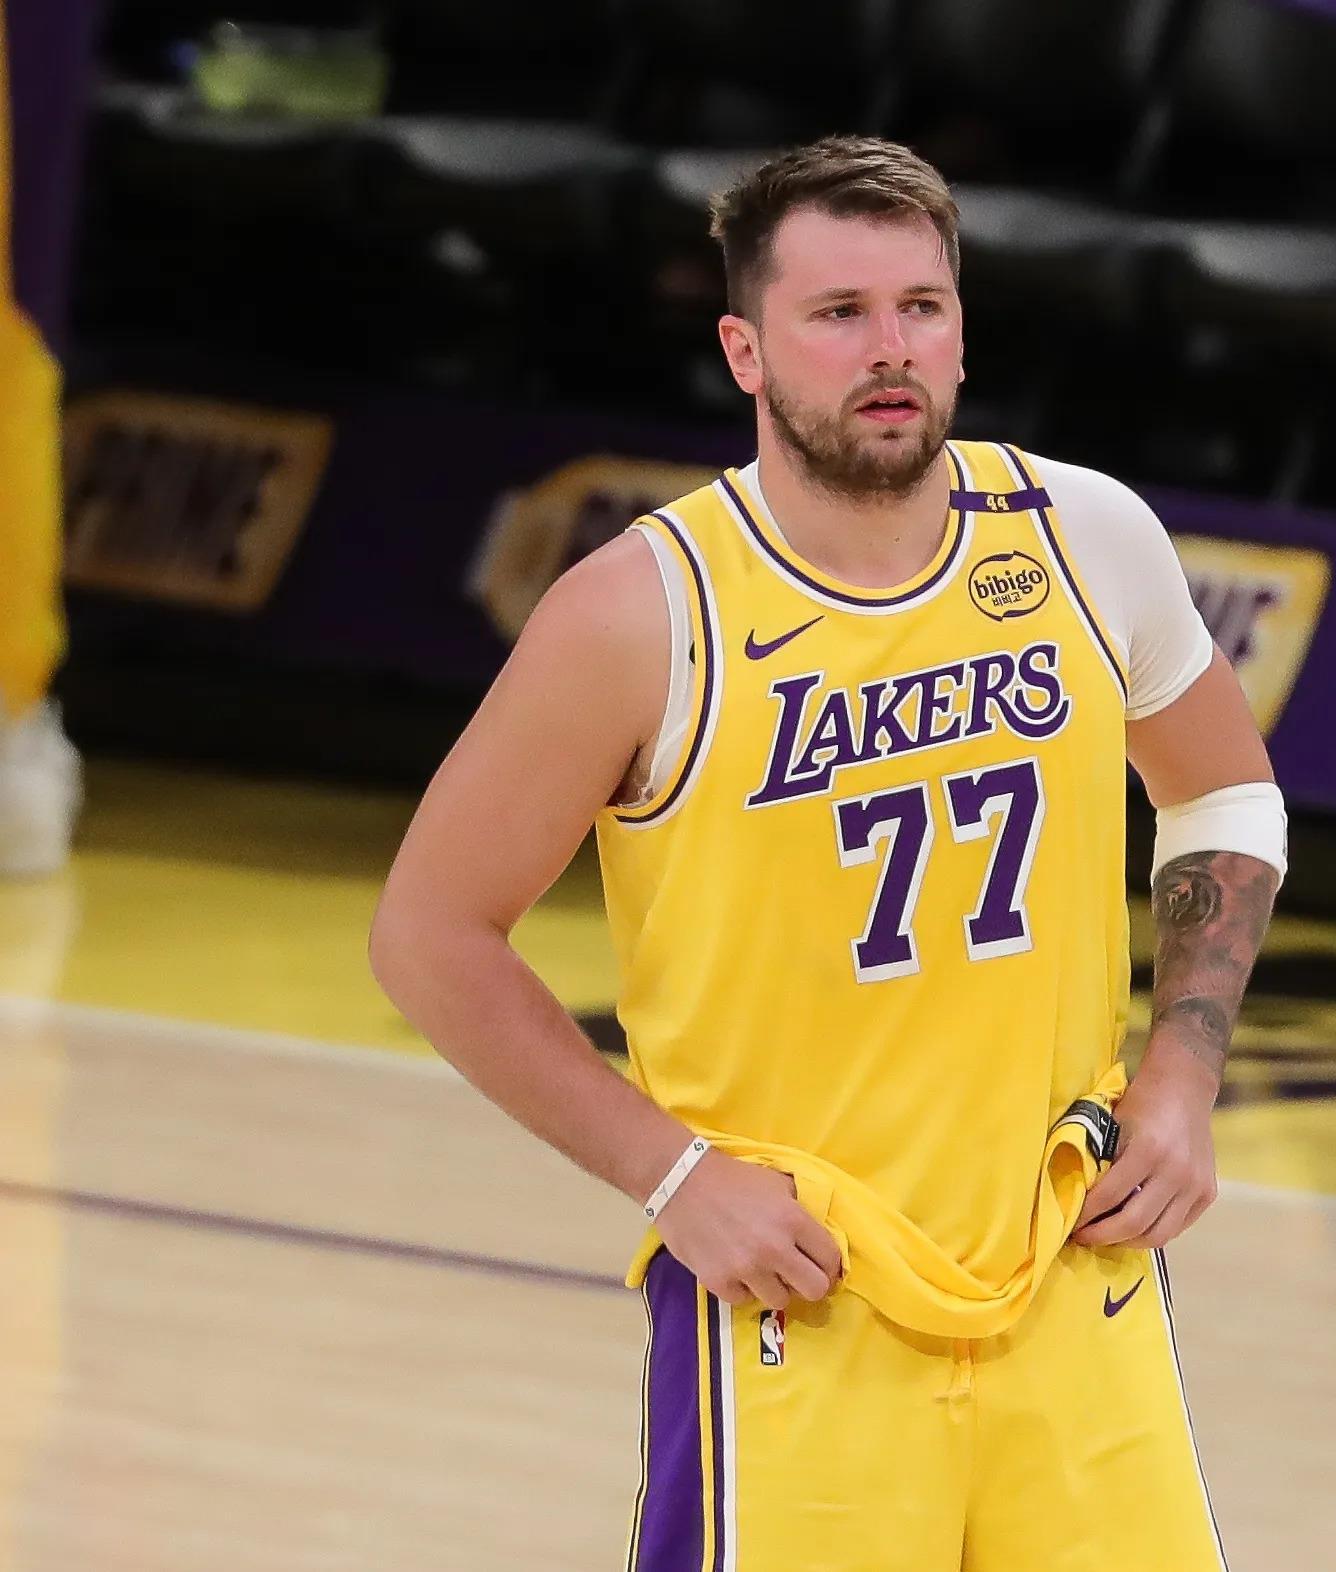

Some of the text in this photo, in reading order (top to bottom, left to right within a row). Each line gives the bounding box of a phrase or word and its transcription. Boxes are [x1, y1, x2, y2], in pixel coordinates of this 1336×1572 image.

[986, 494, 1010, 511] 44
[974, 569, 1043, 599] bibigo
[745, 642, 1071, 808] LAKERS
[832, 756, 1045, 983] 77
